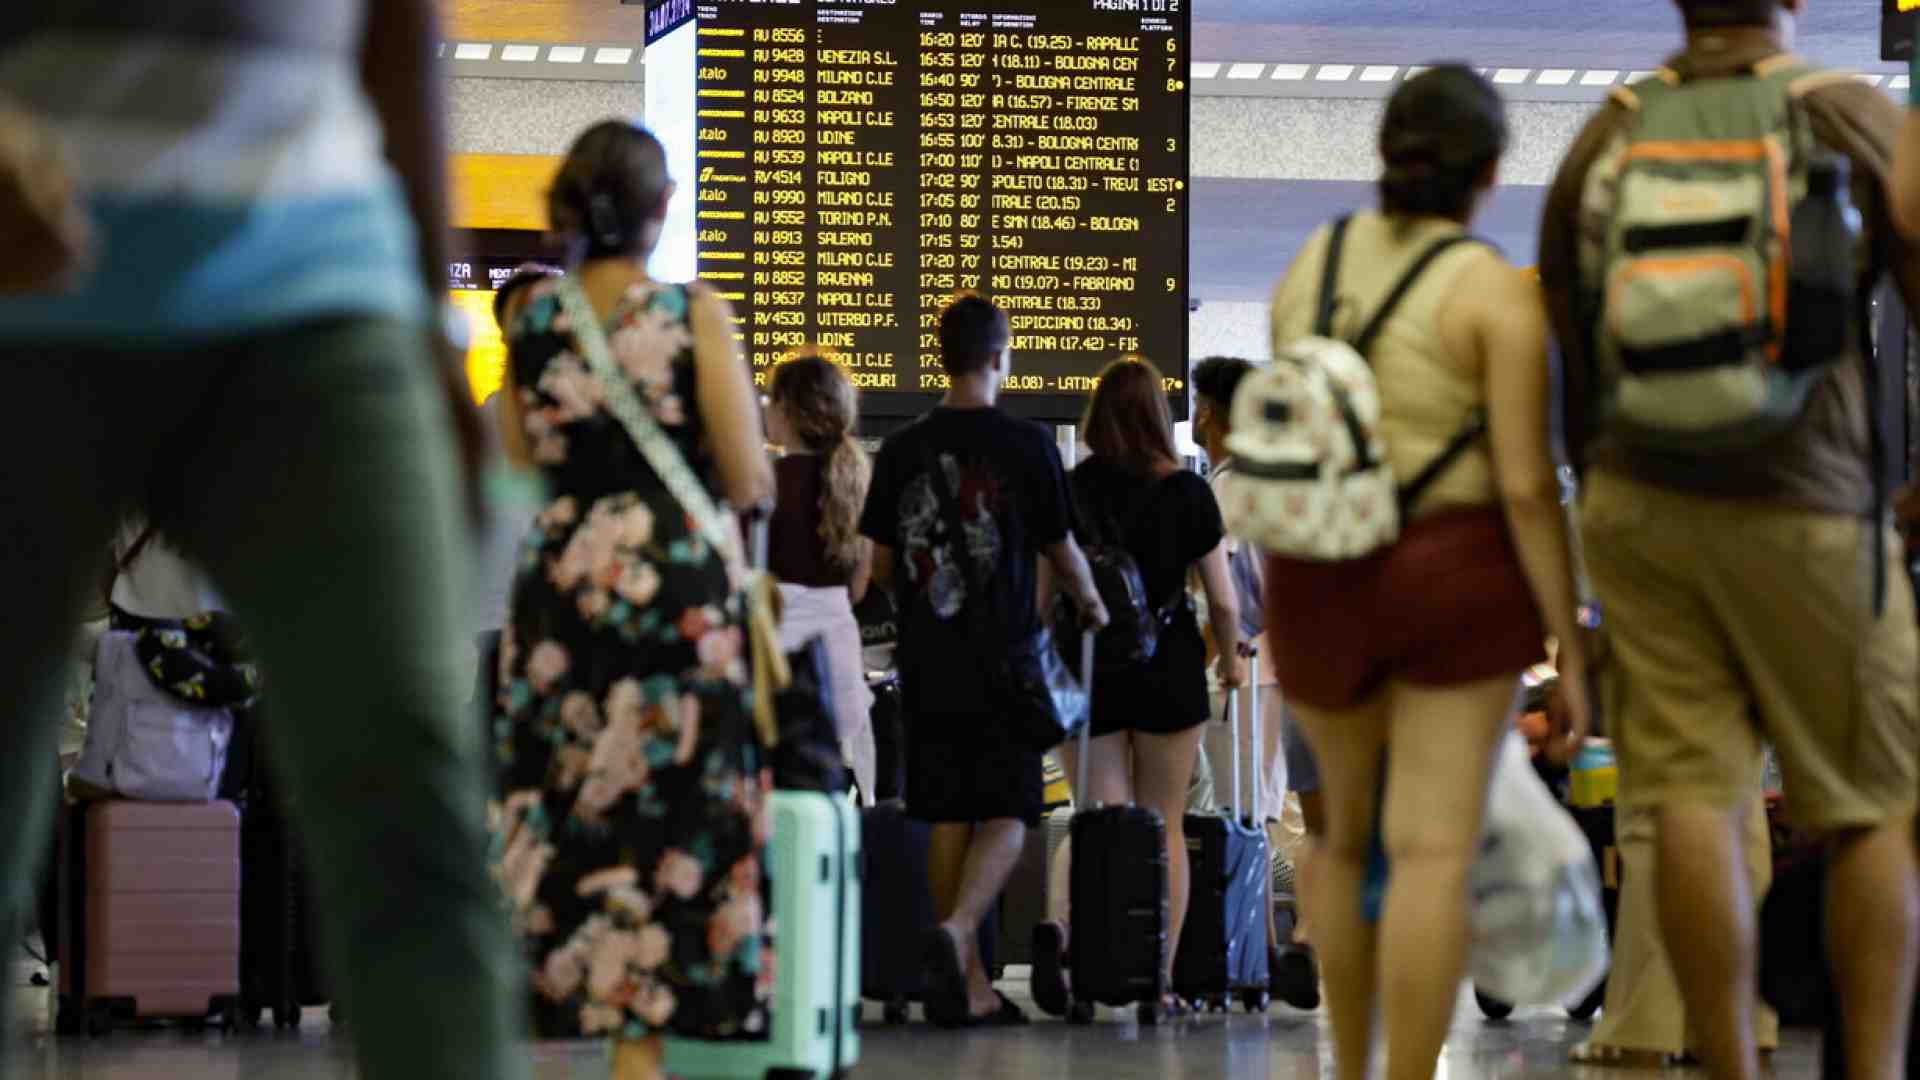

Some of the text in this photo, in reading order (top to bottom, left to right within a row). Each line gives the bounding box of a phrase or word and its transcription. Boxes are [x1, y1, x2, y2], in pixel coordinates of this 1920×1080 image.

[772, 28, 804, 42] 8556
[920, 33, 954, 47] 16:20
[1167, 38, 1175, 52] 6
[772, 48, 805, 63] 9428
[817, 50, 870, 64] VENEZIA
[920, 53, 954, 66] 16:35
[1055, 56, 1109, 70] BOLOGNA
[1167, 58, 1175, 71] 7
[772, 69, 805, 83] 9948
[817, 70, 862, 84] MILANO
[920, 73, 954, 86] 16:40
[1016, 75, 1070, 89] BOLOGNA
[1074, 76, 1134, 90] CENTRALE
[1167, 78, 1175, 91] 8
[772, 89, 804, 103] 8524
[817, 90, 872, 105] BOLZANO
[920, 93, 955, 107] 16:50
[1067, 96, 1118, 110] FIRENZE
[772, 109, 805, 123] 9633
[817, 111, 862, 125] NAPOLI
[920, 113, 955, 127] 16:53
[772, 129, 805, 144] 8920
[817, 131, 855, 144] UDINE
[920, 133, 955, 147] 16:55
[1039, 136, 1092, 149] BOLOGNA
[1167, 139, 1175, 152] 3
[772, 150, 805, 163] 9539
[817, 151, 862, 165] NAPOLI
[920, 153, 955, 167] 17:00
[1017, 156, 1060, 169] NAPOLI
[1065, 156, 1125, 171] CENTRALE
[817, 171, 870, 185] FOLIGNO
[920, 173, 954, 187] 17:02
[1104, 177, 1138, 191] TREVI
[772, 190, 805, 204] 9990
[817, 191, 863, 205] MILANO
[920, 193, 955, 208] 17:05
[1167, 198, 1175, 211] 2
[772, 211, 805, 224] 9552
[818, 211, 864, 225] TORINO
[920, 213, 952, 227] 17:10
[772, 231, 802, 244] 8913
[817, 232, 872, 246] SALERNO
[920, 234, 952, 247] 17:15
[772, 251, 805, 265] 9652
[817, 252, 863, 266] MILANO
[920, 254, 954, 268] 17:20
[1000, 255, 1060, 269] CENTRALE
[772, 271, 805, 285] 8852
[817, 272, 873, 286] RAVENNA
[920, 274, 954, 288] 17:25
[1073, 276, 1134, 290] FABRIANO
[1167, 278, 1175, 291] 9
[772, 291, 805, 305] 9637
[817, 292, 861, 306] NAPOLI
[817, 312, 871, 326] VITERBO
[1012, 316, 1084, 330] SIPICCIANO
[772, 331, 805, 345] 9430
[817, 332, 855, 346] UDINE
